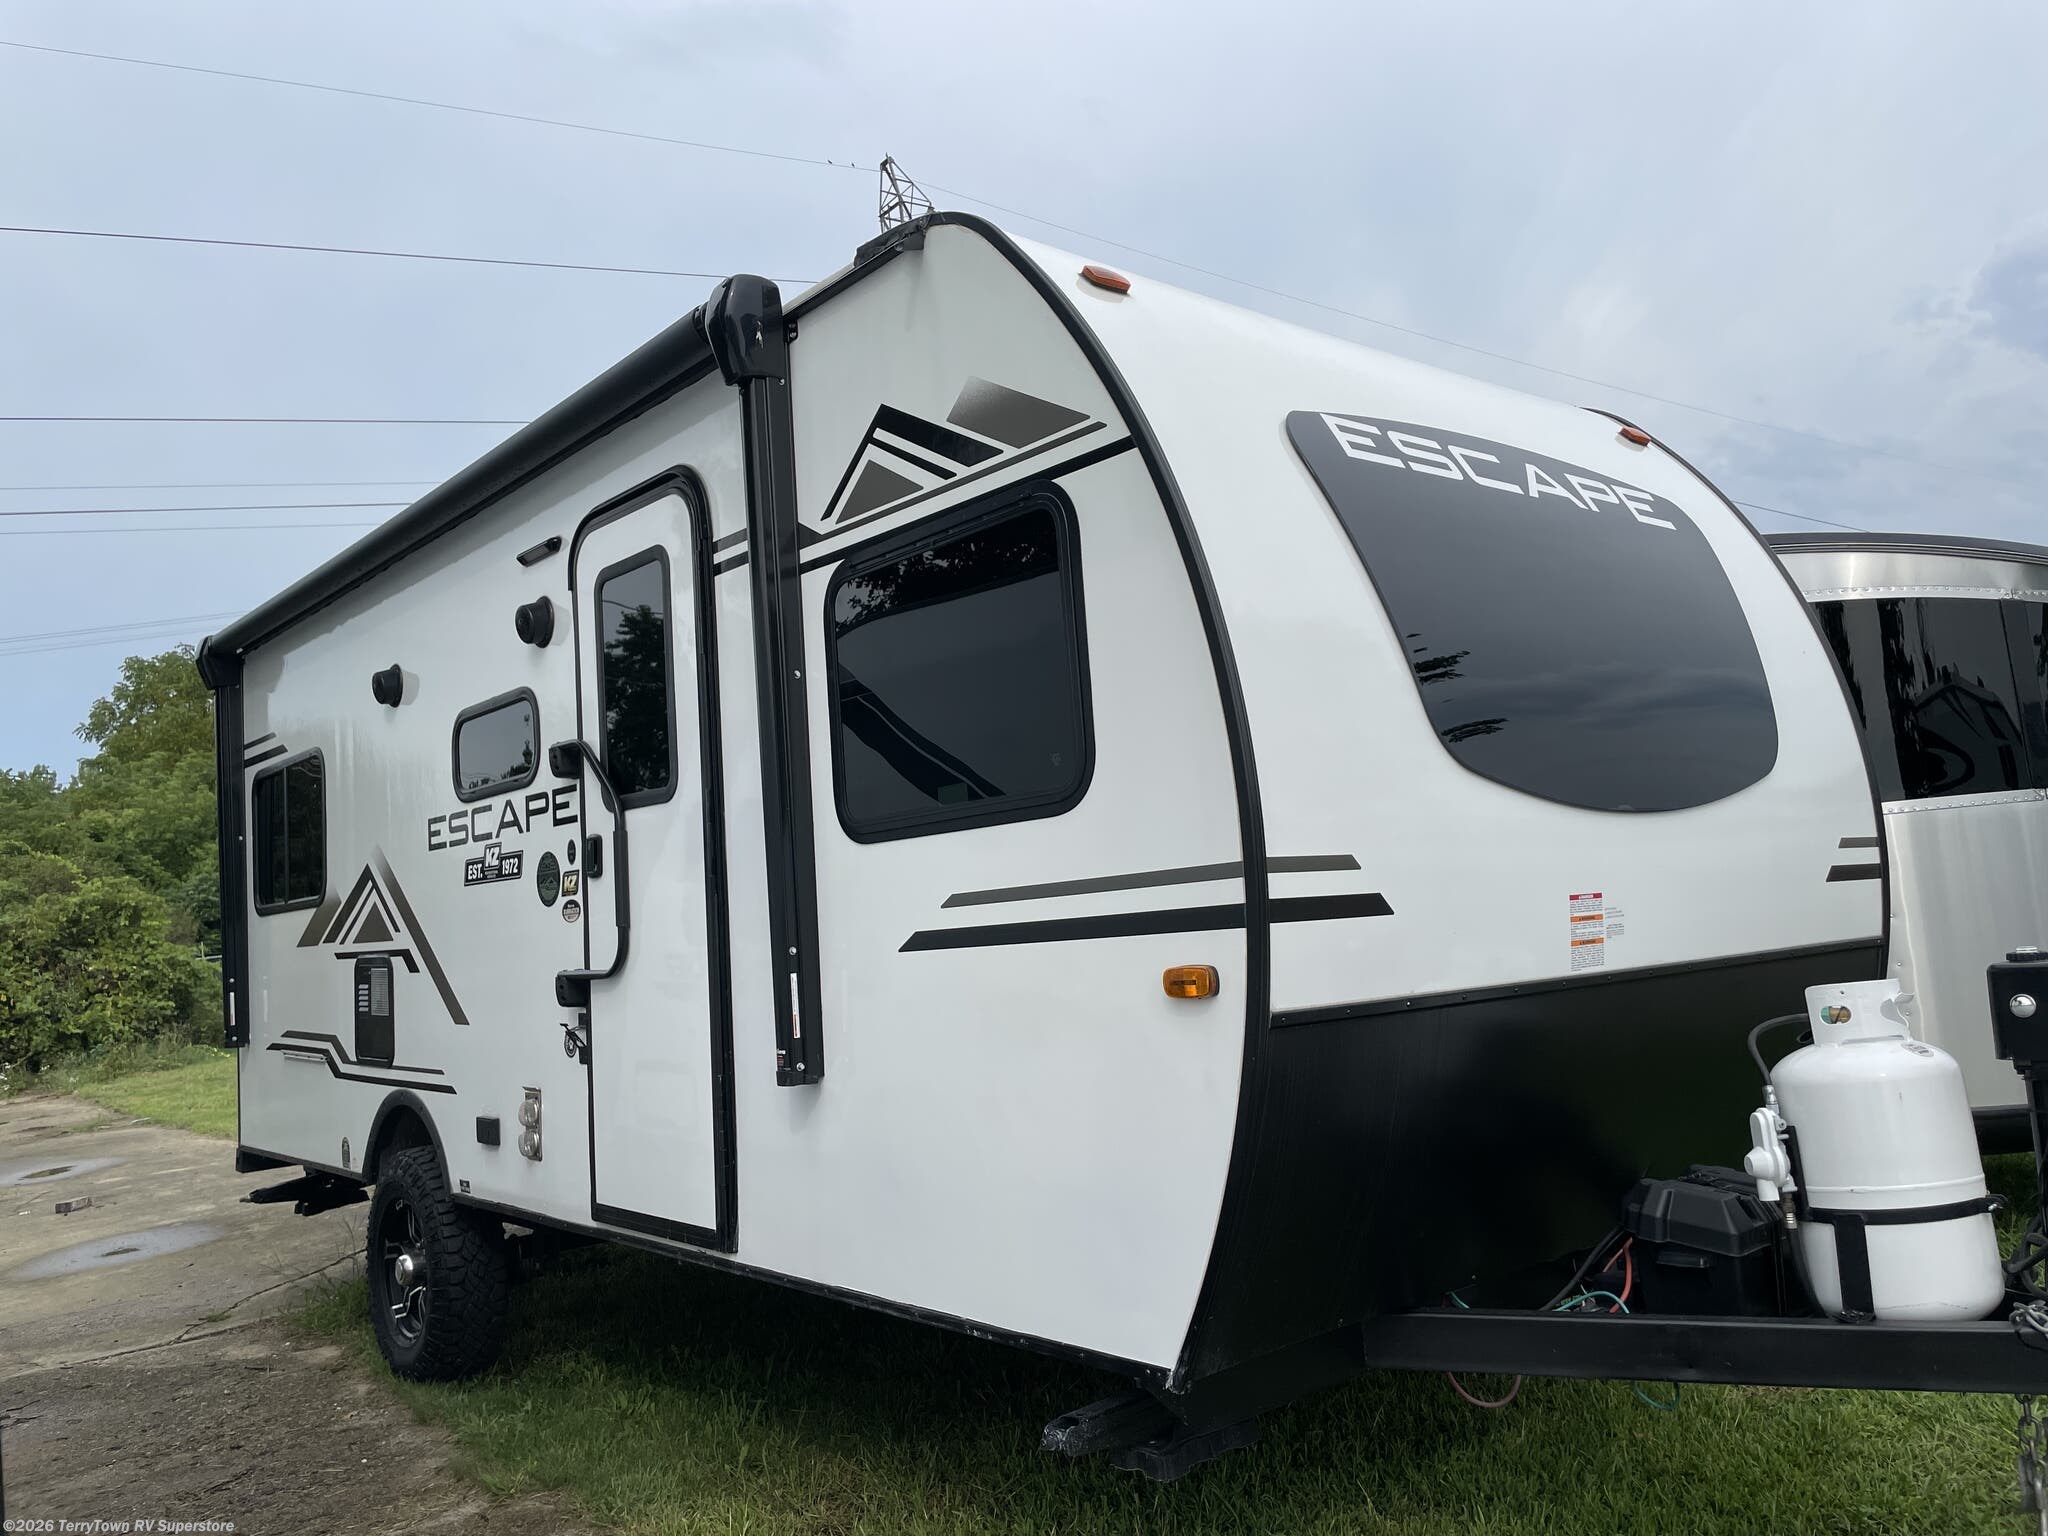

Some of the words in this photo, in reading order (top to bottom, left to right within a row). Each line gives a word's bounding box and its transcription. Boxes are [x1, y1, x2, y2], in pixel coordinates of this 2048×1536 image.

[1319, 412, 1677, 531] ESCAPE
[427, 784, 578, 851] ESCAPE
[468, 864, 483, 880] EST.
[502, 857, 519, 875] 1972
[485, 847, 500, 867] KZ
[563, 875, 577, 892] KZ
